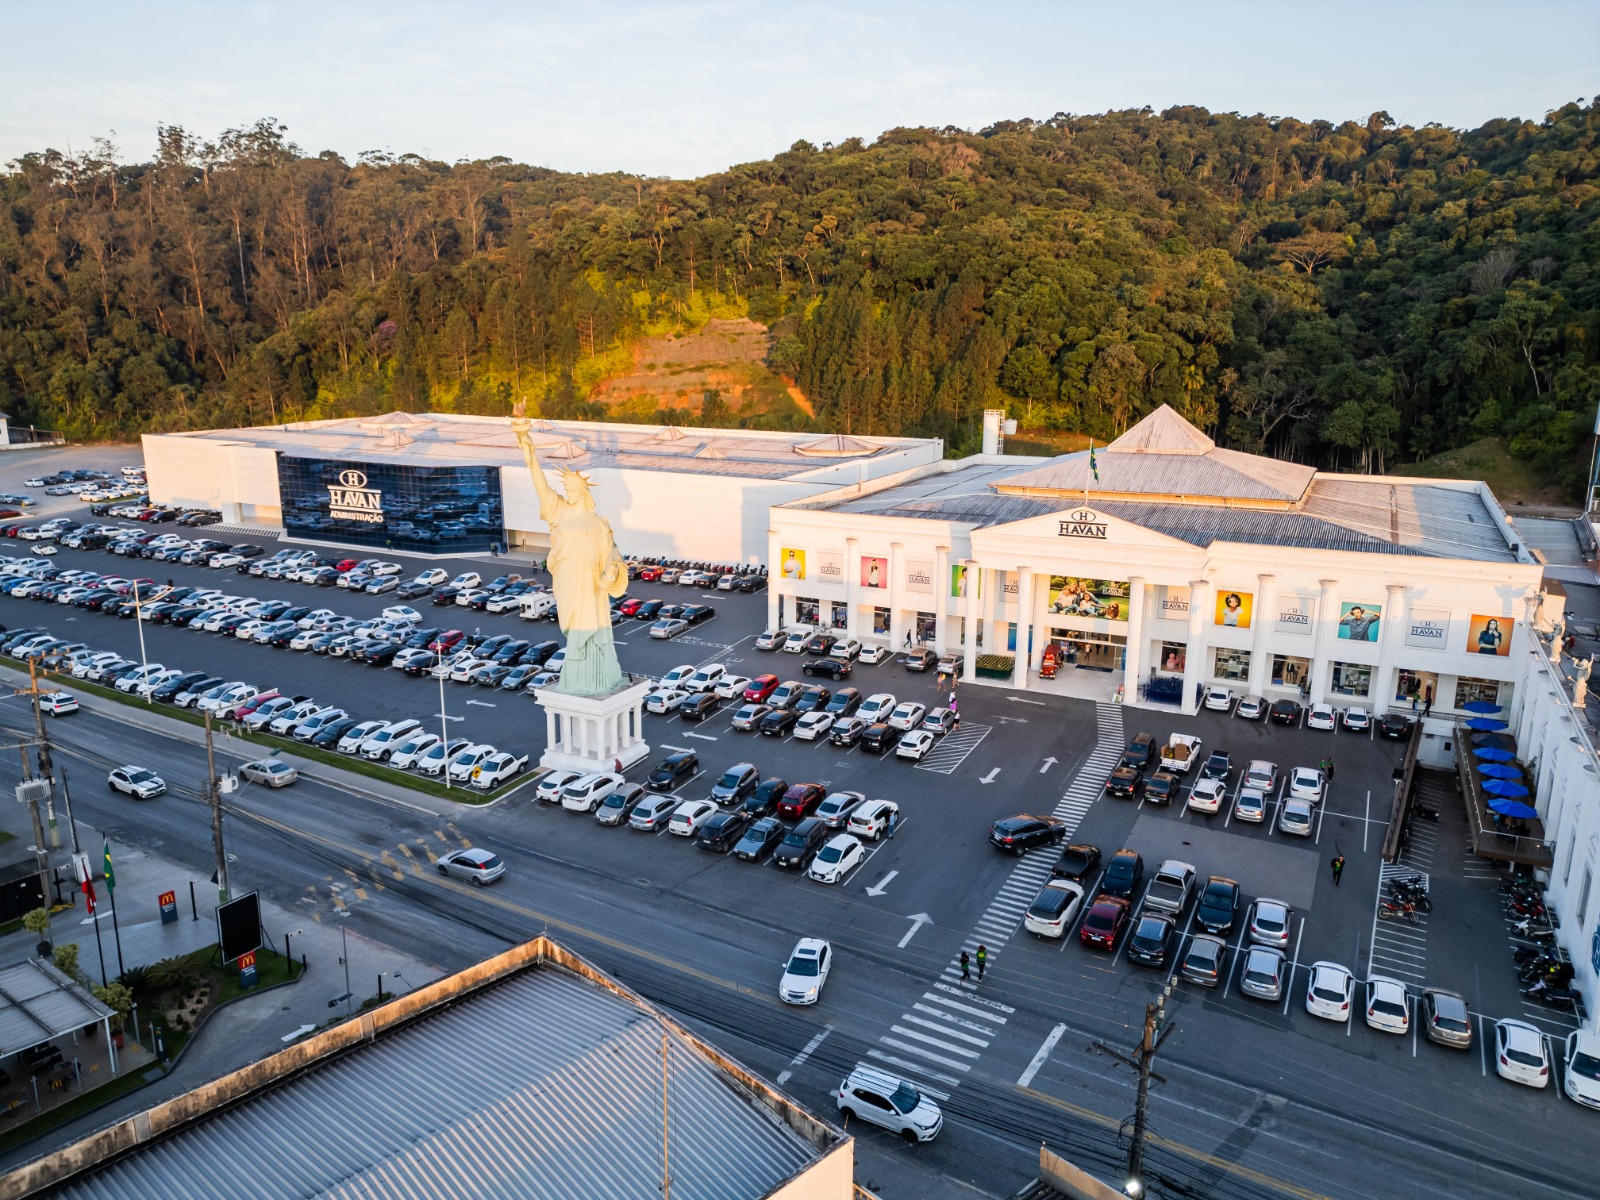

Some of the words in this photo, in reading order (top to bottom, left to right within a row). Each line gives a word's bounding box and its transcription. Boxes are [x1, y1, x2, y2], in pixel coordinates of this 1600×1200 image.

[329, 489, 381, 510] HAVAN
[330, 510, 384, 523] ADMINISTRAÇÃO
[1059, 523, 1107, 537] HAVAN
[820, 566, 840, 575] HAVAN
[909, 576, 930, 584] HAVAN
[1162, 601, 1188, 610] HAVAN
[1279, 613, 1308, 623] HAVAN
[1410, 626, 1443, 637] HAVAN
